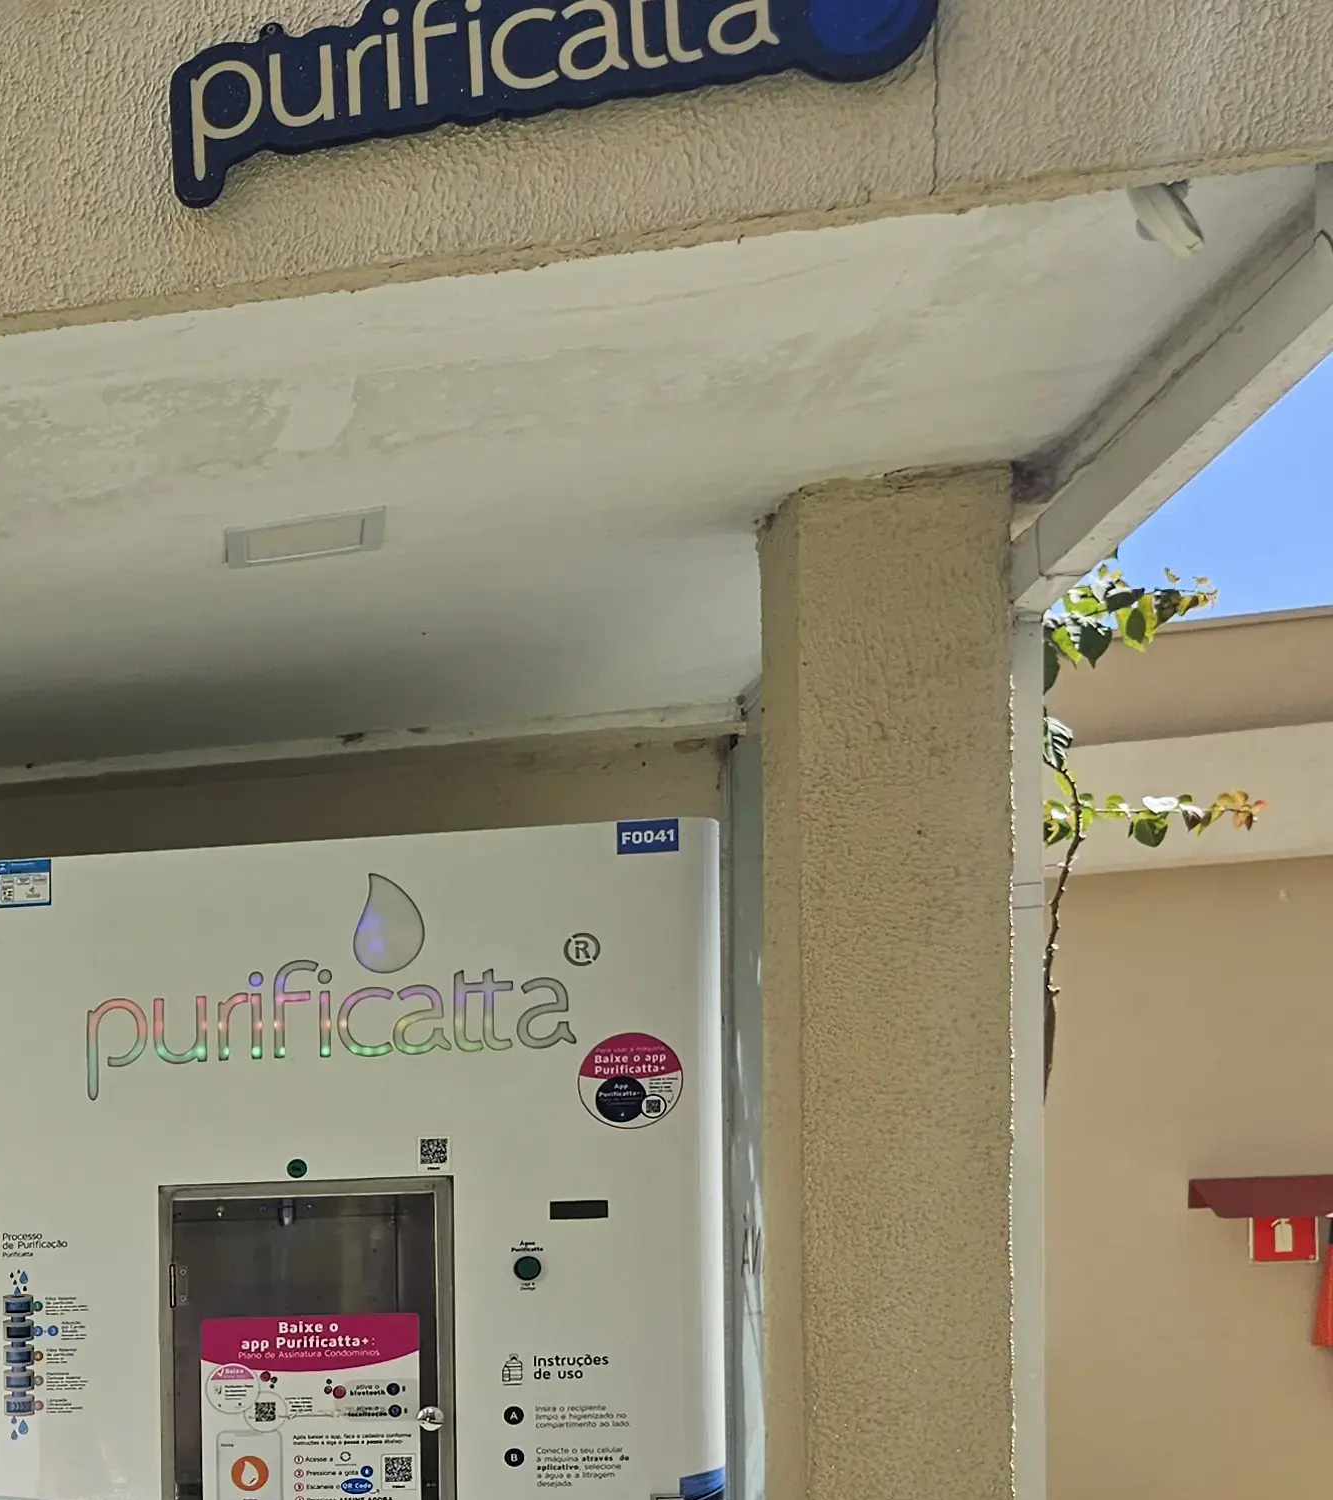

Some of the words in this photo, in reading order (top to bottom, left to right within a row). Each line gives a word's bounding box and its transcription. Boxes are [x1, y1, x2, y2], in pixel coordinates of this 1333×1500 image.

[621, 827, 675, 847] F0041
[86, 959, 576, 1100] purificatta
[594, 1053, 628, 1064] Baixe
[645, 1054, 667, 1062] app
[594, 1063, 666, 1075] Purificatta+
[2, 1232, 43, 1241] Processo
[2, 1242, 14, 1250] de
[17, 1240, 68, 1249] Purificação
[278, 1321, 323, 1334] Baixe
[329, 1322, 339, 1331] o
[241, 1340, 270, 1352] app
[238, 1351, 263, 1360] Plano
[278, 1350, 322, 1358] Assinatura
[533, 1354, 609, 1368] Instruções
[534, 1369, 551, 1379] de
[557, 1369, 584, 1379] uso
[567, 1405, 607, 1414] recipiente
[510, 1411, 518, 1420] A
[535, 1413, 558, 1422] limpo
[569, 1412, 614, 1421] higienizado
[535, 1421, 597, 1430] compartimento
[510, 1454, 518, 1462] B
[581, 1454, 614, 1462] através
